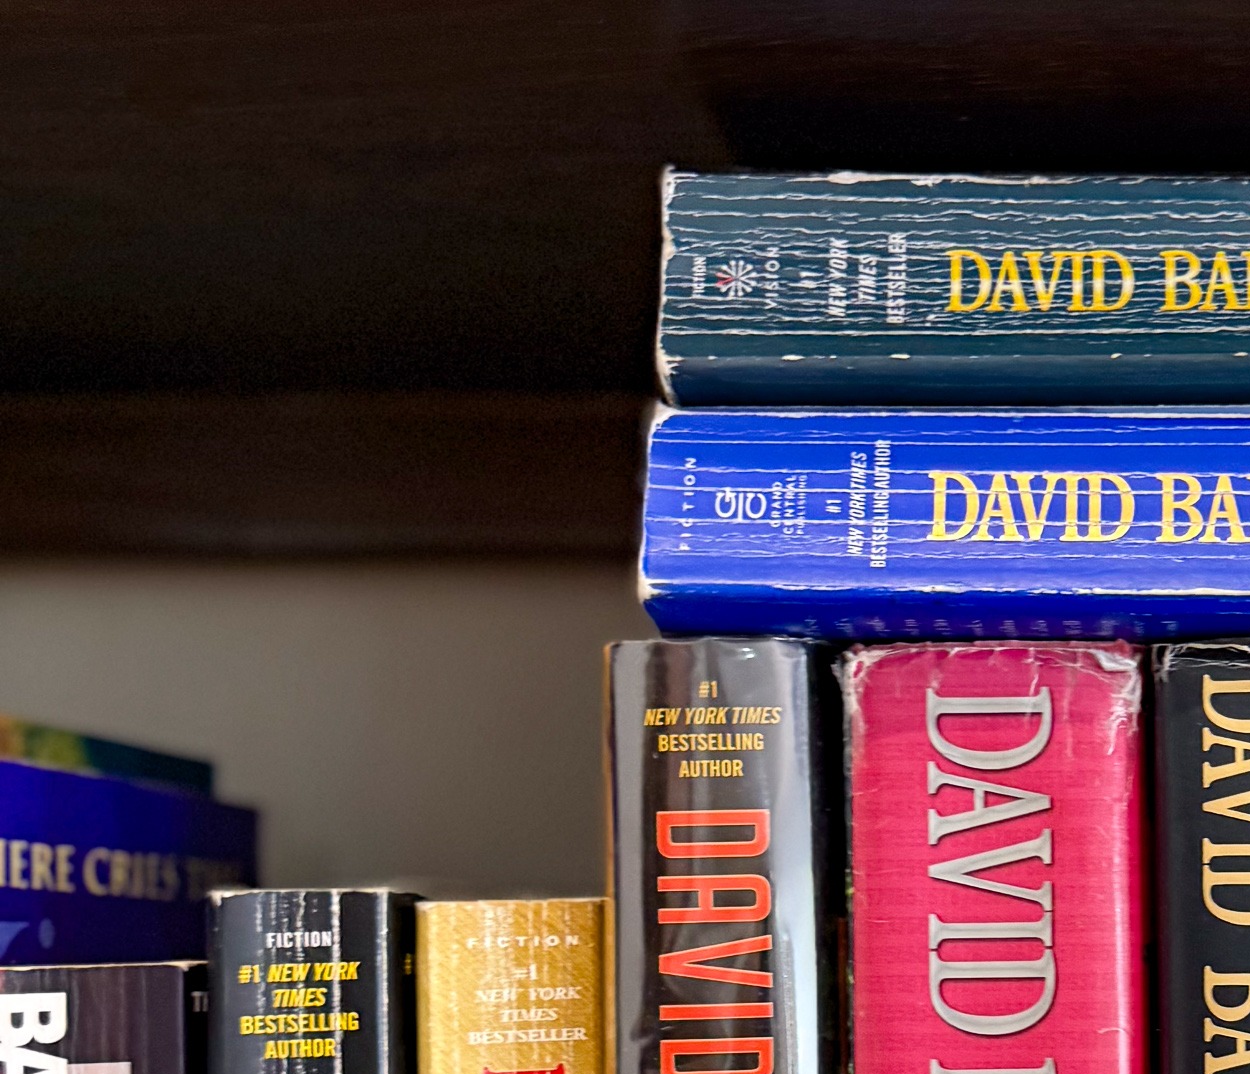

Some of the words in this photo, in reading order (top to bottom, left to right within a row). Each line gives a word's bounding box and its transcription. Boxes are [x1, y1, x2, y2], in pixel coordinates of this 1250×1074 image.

[830, 237, 849, 278] YORK
[764, 247, 781, 310] VISION
[858, 254, 878, 301] TIMES
[886, 232, 908, 324] BESTSELLER
[944, 250, 1135, 312] DAVID
[828, 283, 848, 317] NEW
[850, 450, 868, 491] TIMES
[873, 439, 892, 488] AUTHOR
[679, 457, 698, 551] FICTION
[771, 481, 784, 528] GRAND
[783, 475, 797, 535] CENTRAL
[826, 499, 842, 514] #1
[849, 492, 866, 527] YORK
[926, 471, 1135, 542] DAVID
[847, 527, 864, 555] NEW
[870, 489, 889, 568] BESTSELLING
[699, 681, 718, 699] #1
[644, 708, 680, 727] NEW
[684, 707, 727, 725] YORK
[731, 706, 782, 725] TIMES
[658, 733, 764, 752] BESTSELLING
[678, 759, 744, 779] AUTHOR
[926, 686, 1058, 1036] DAVID
[265, 931, 332, 948] FICTION
[466, 935, 580, 949] FICTION
[238, 965, 261, 983] #1
[267, 963, 309, 982] NEW
[311, 961, 361, 981] YORK
[272, 988, 327, 1008] TIMES
[475, 987, 522, 1003] NEW
[529, 986, 582, 1000] YORK
[239, 1011, 360, 1035] BESTSELLING
[500, 1007, 559, 1022] TIMES
[264, 1038, 337, 1060] AUTHOR
[468, 1027, 588, 1045] BESTSELLER
